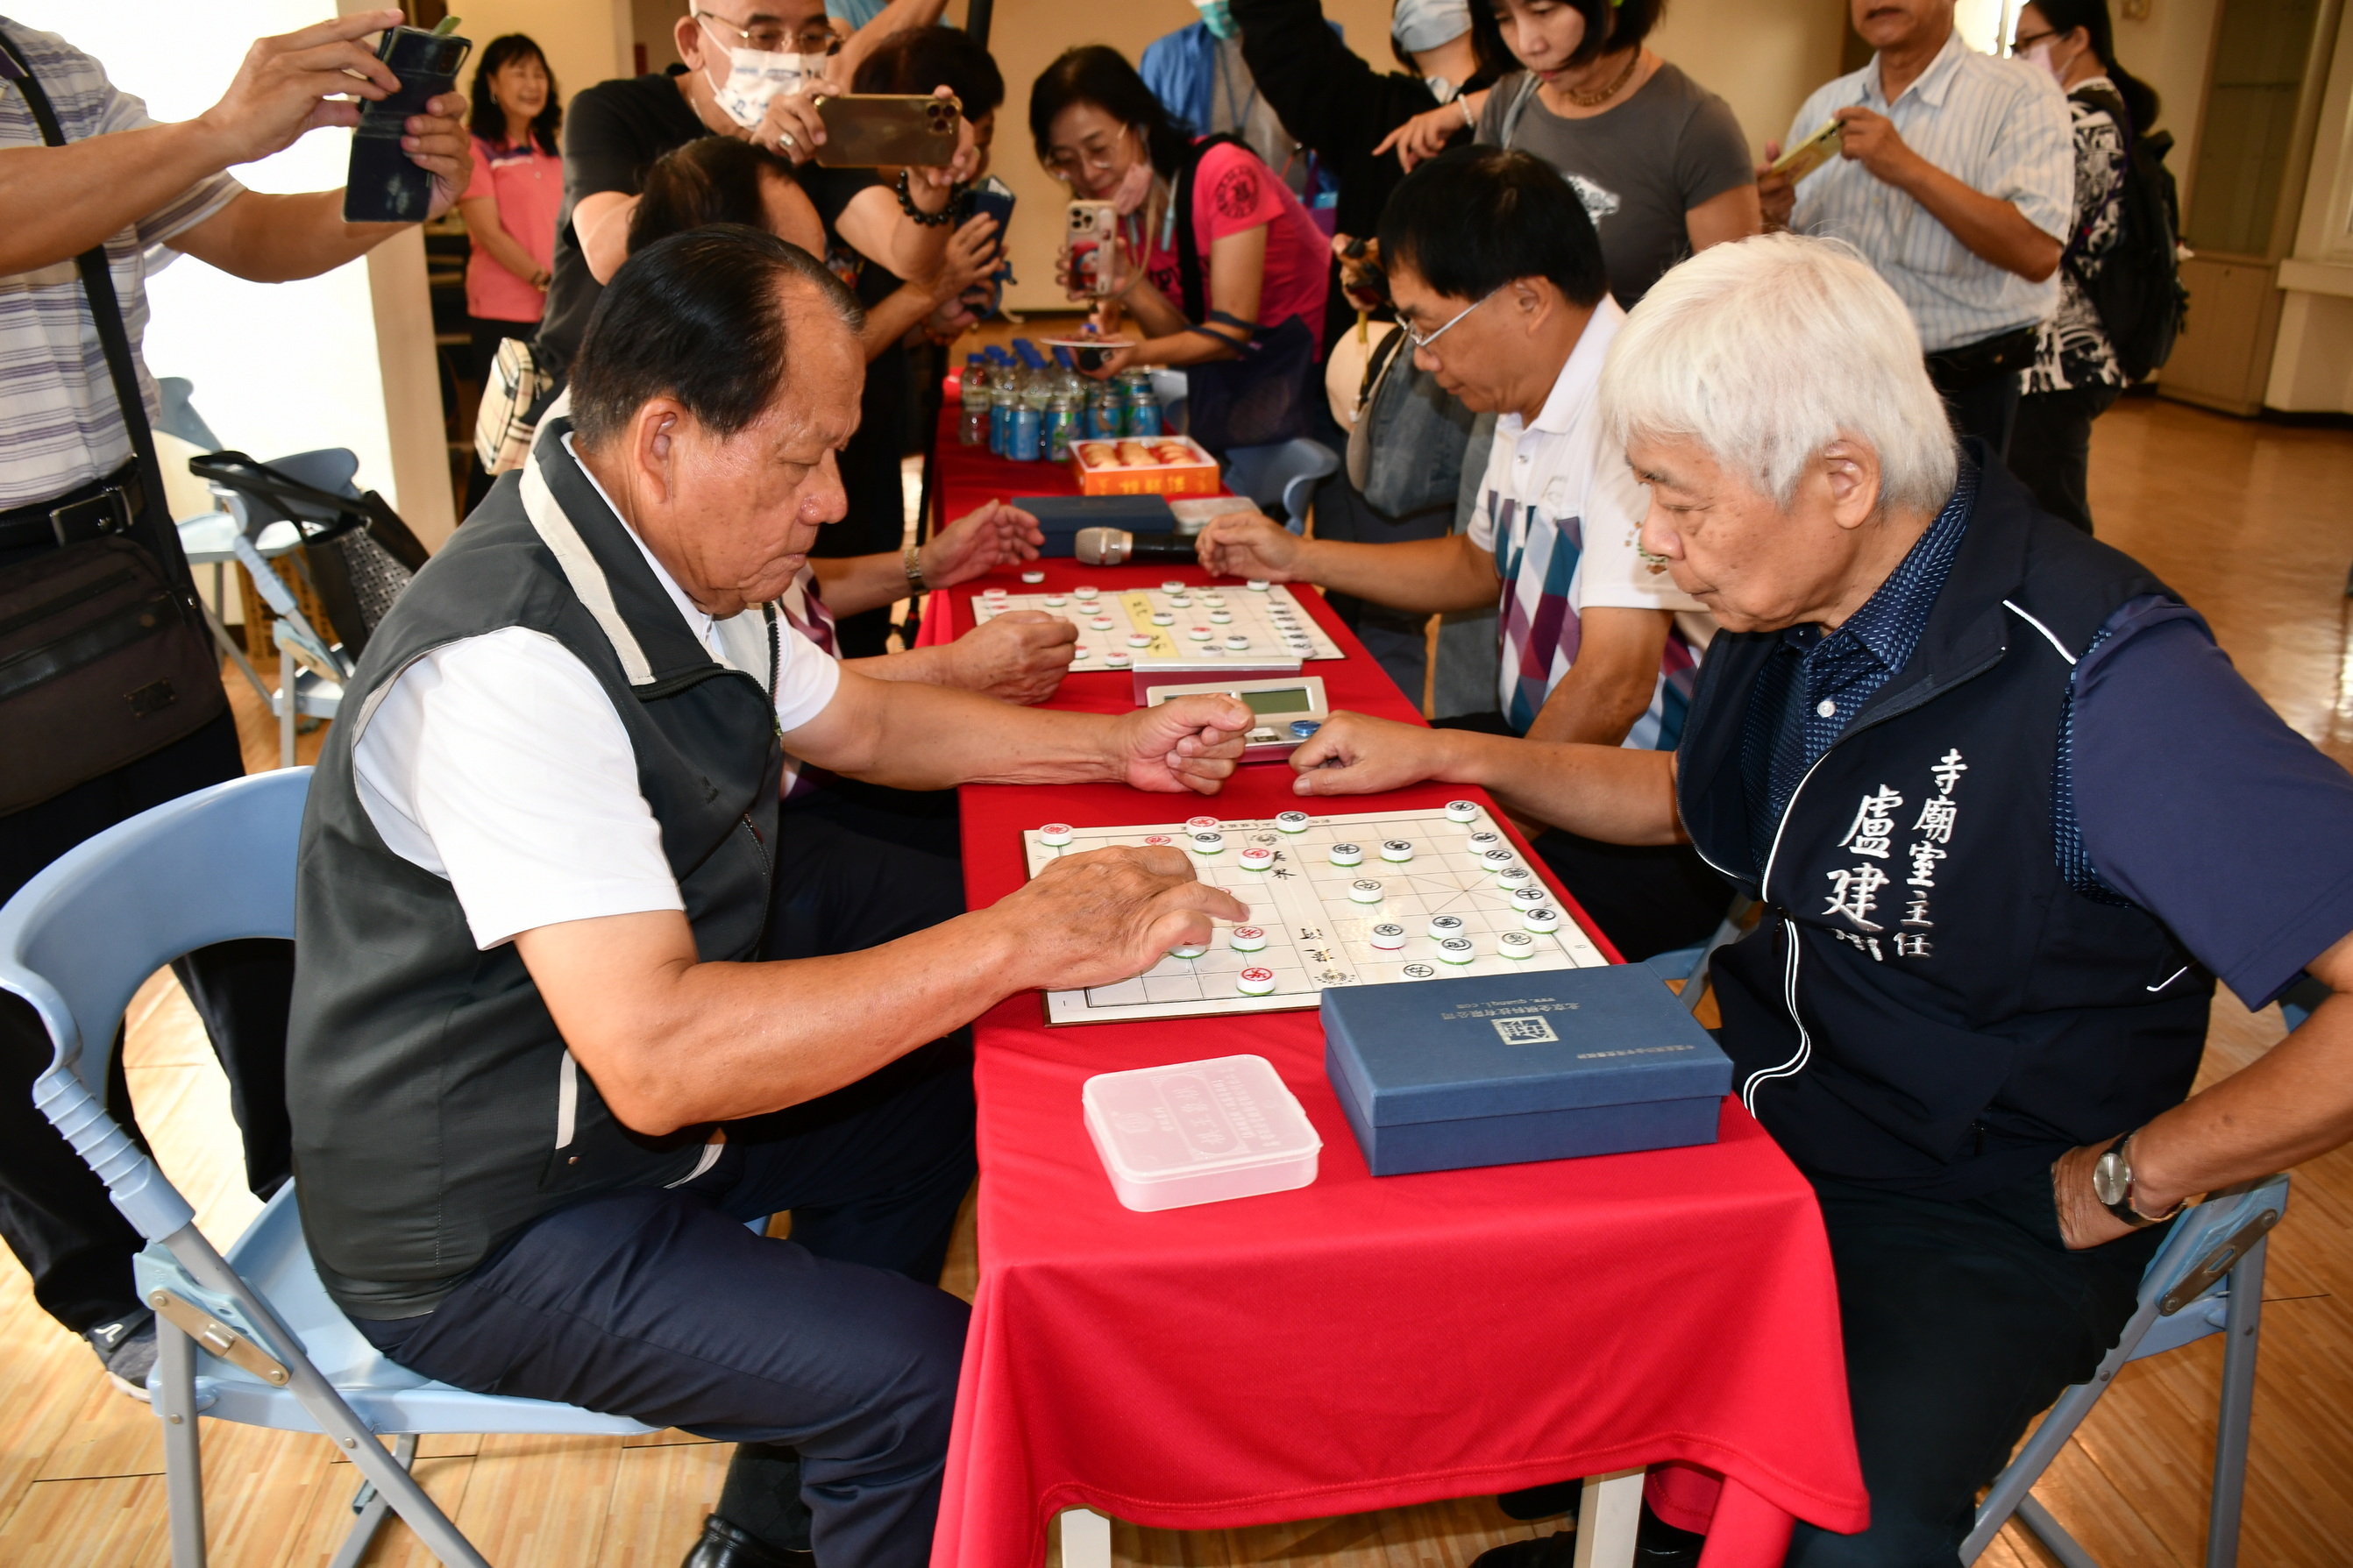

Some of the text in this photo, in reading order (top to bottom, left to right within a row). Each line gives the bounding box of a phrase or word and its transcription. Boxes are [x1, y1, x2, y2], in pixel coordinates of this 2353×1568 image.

[1893, 748, 1968, 958] 寺廟室主任
[1456, 998, 1556, 1009] www.quanqi.com
